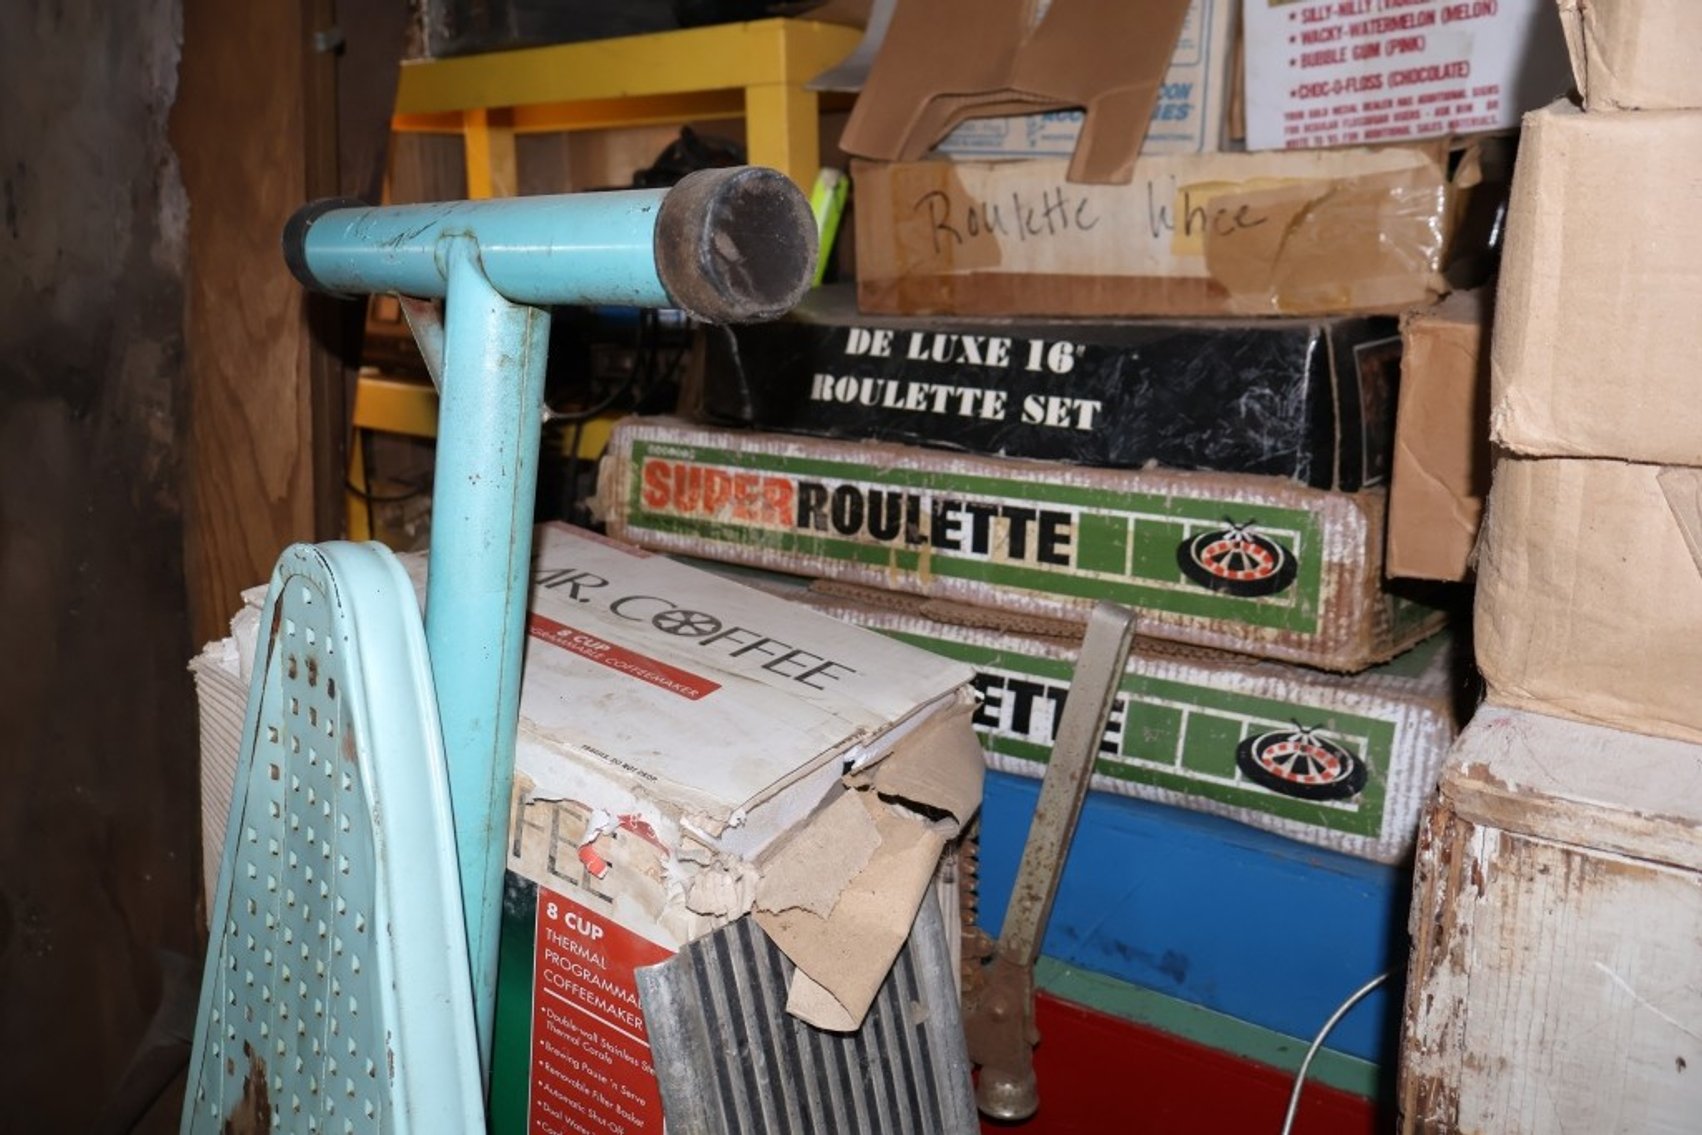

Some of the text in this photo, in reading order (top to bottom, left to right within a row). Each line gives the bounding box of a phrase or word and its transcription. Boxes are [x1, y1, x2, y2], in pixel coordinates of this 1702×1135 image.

[1352, 42, 1380, 61] GUM
[913, 186, 1100, 254] Roulette
[845, 327, 894, 356] DE
[907, 332, 1012, 367] LUXE
[811, 373, 1102, 430] ROULETTE SET
[573, 634, 611, 651] CUP
[546, 902, 604, 940] 8 CUP
[545, 927, 607, 970] THERMAL
[543, 968, 644, 1032] COFFEEMAKER
